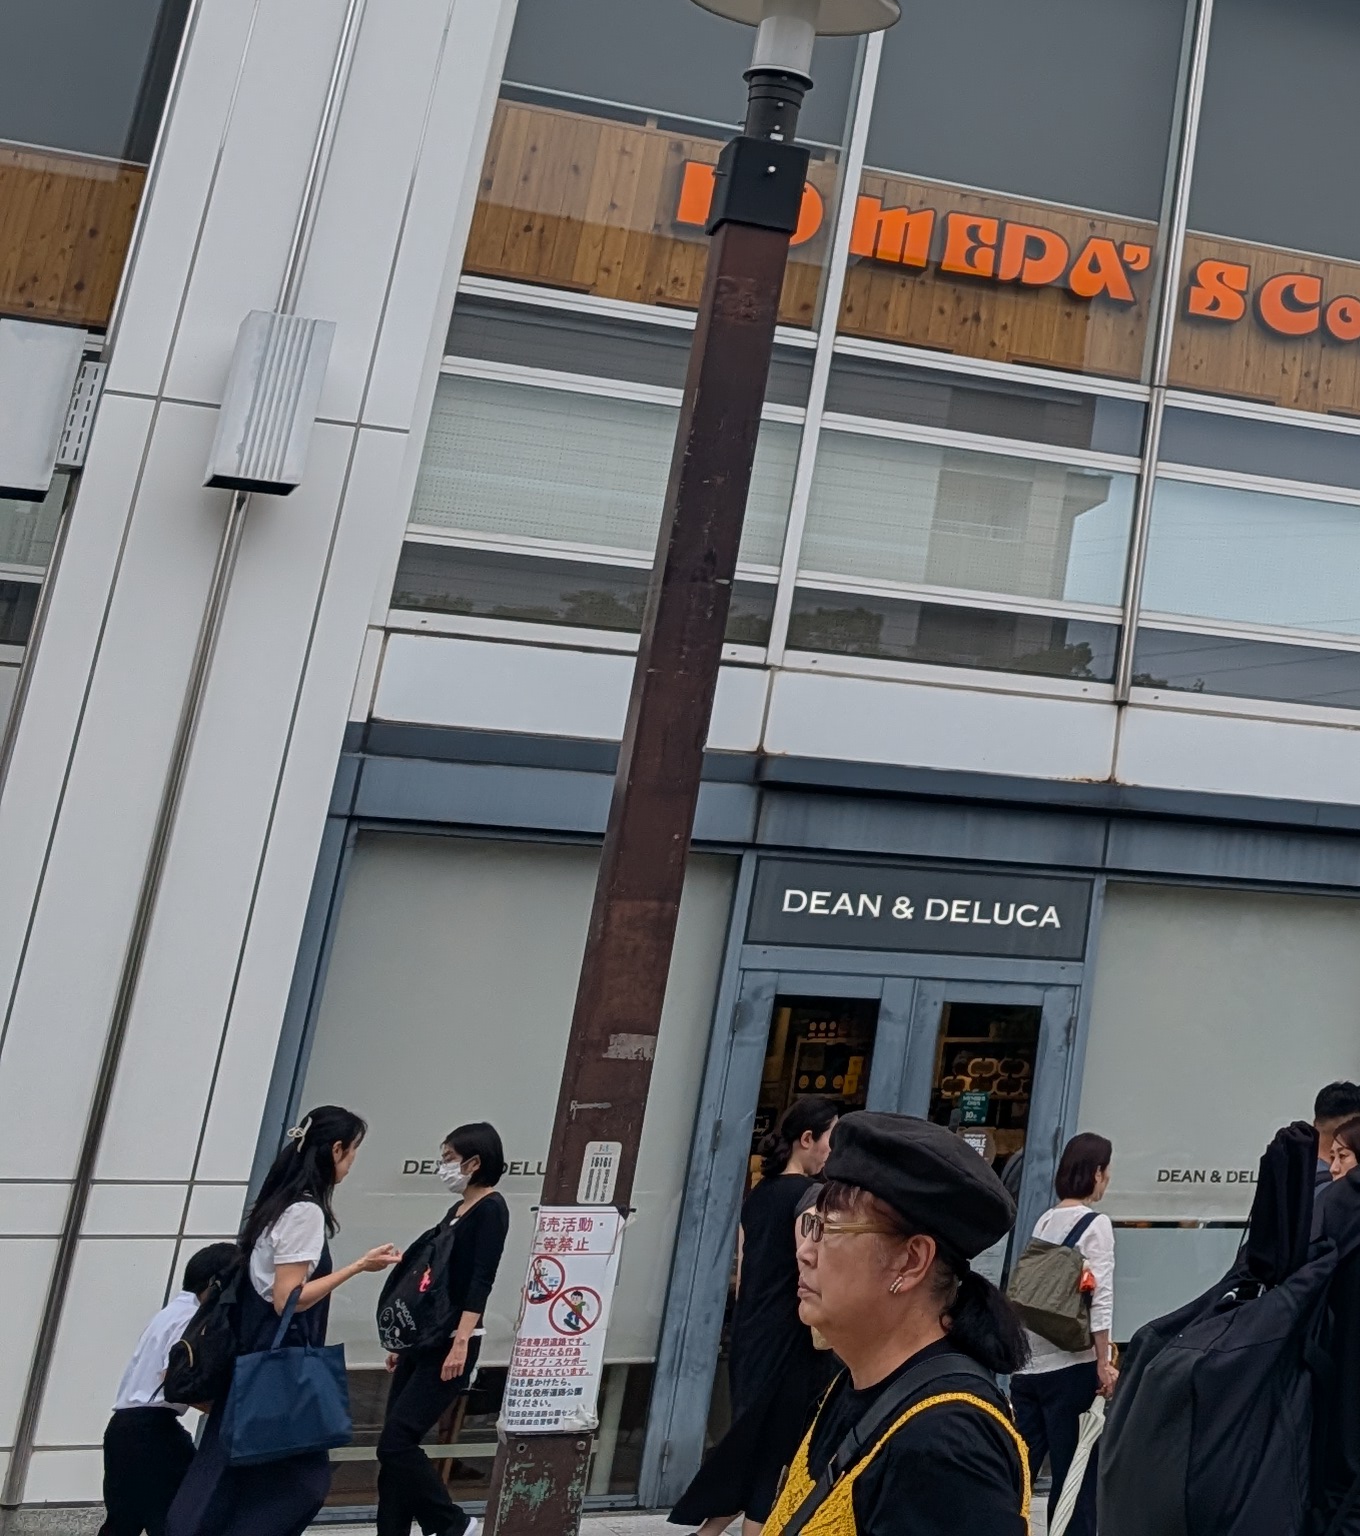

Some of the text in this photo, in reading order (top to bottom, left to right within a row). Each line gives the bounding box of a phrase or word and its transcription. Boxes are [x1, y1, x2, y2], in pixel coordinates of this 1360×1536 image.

[782, 888, 1061, 929] DEAN & DELUCA
[1157, 1169, 1259, 1184] DEAN & DEL
